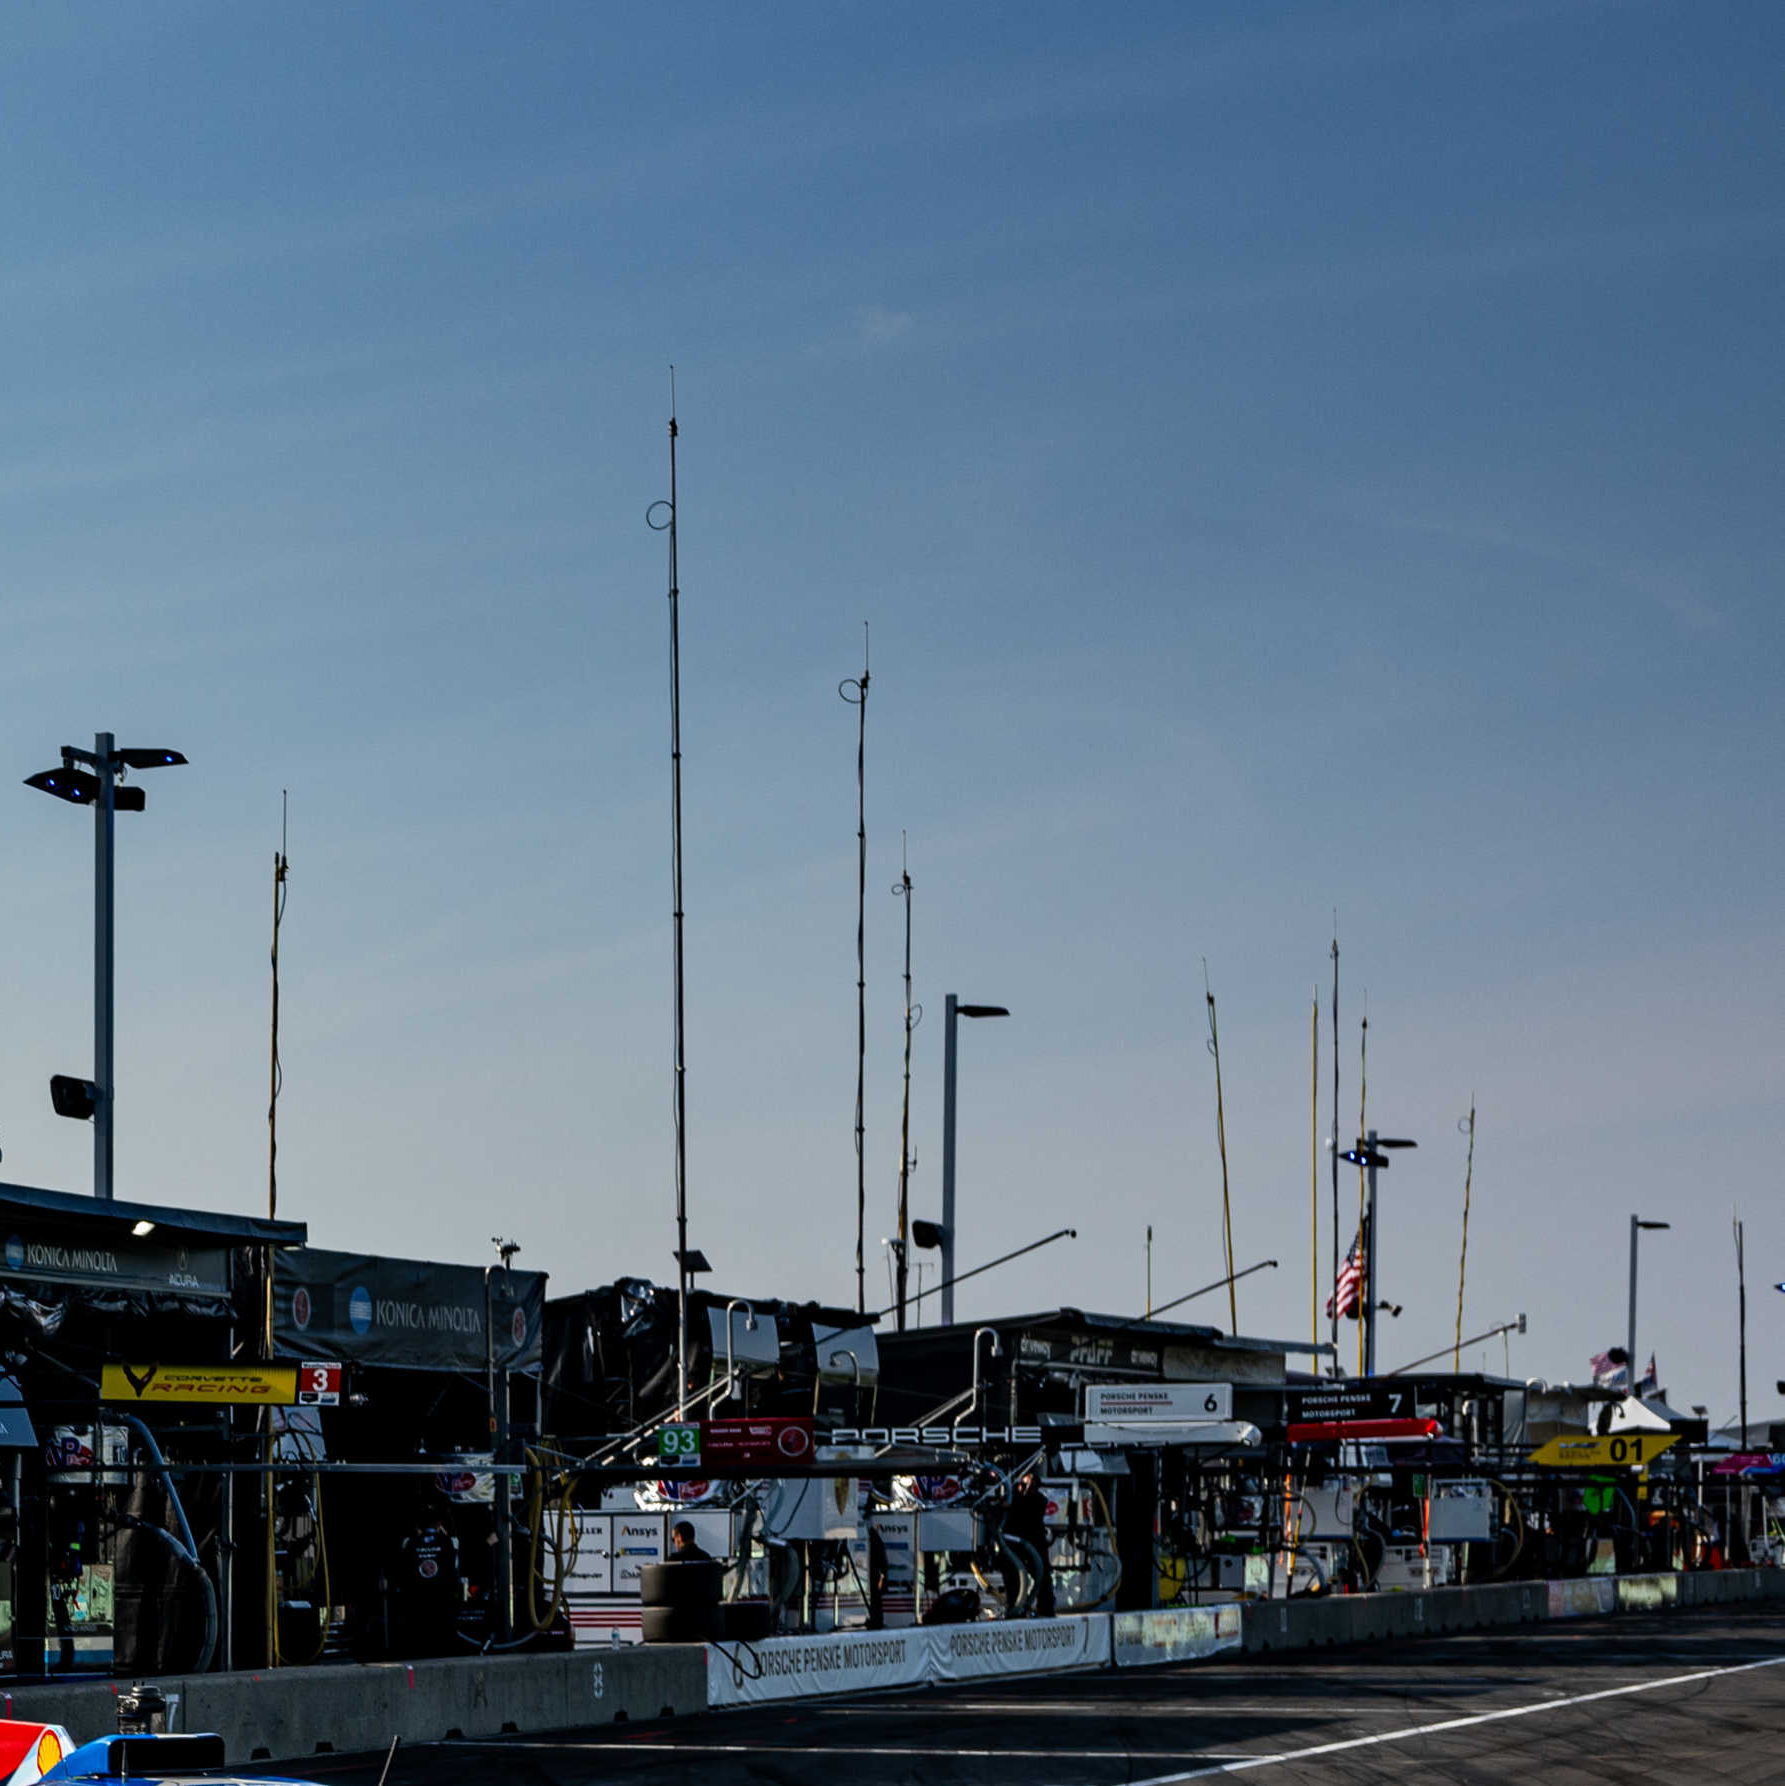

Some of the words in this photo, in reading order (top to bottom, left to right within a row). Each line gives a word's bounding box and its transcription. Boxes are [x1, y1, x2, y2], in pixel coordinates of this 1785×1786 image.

[27, 1244, 70, 1268] KONICA
[72, 1250, 118, 1273] MINOLTA
[169, 1274, 199, 1287] ACURA
[377, 1301, 425, 1328] KONICA
[428, 1306, 481, 1334] MINOLTA
[151, 1384, 272, 1394] RACING
[164, 1375, 262, 1383] CORVETTE
[312, 1369, 329, 1392] 3
[1204, 1394, 1217, 1411] 6
[1388, 1394, 1403, 1414] 7
[662, 1430, 696, 1455] 93
[831, 1427, 1042, 1446] PORSCHE
[1611, 1438, 1643, 1462] 01
[622, 1525, 658, 1539] Ansys
[950, 1633, 990, 1658] PORSCHE
[992, 1629, 1023, 1652] PENSKE
[1025, 1626, 1076, 1651] MOTORSPORT
[804, 1645, 841, 1673] PENSKE
[844, 1640, 906, 1667] MOTORSPORT
